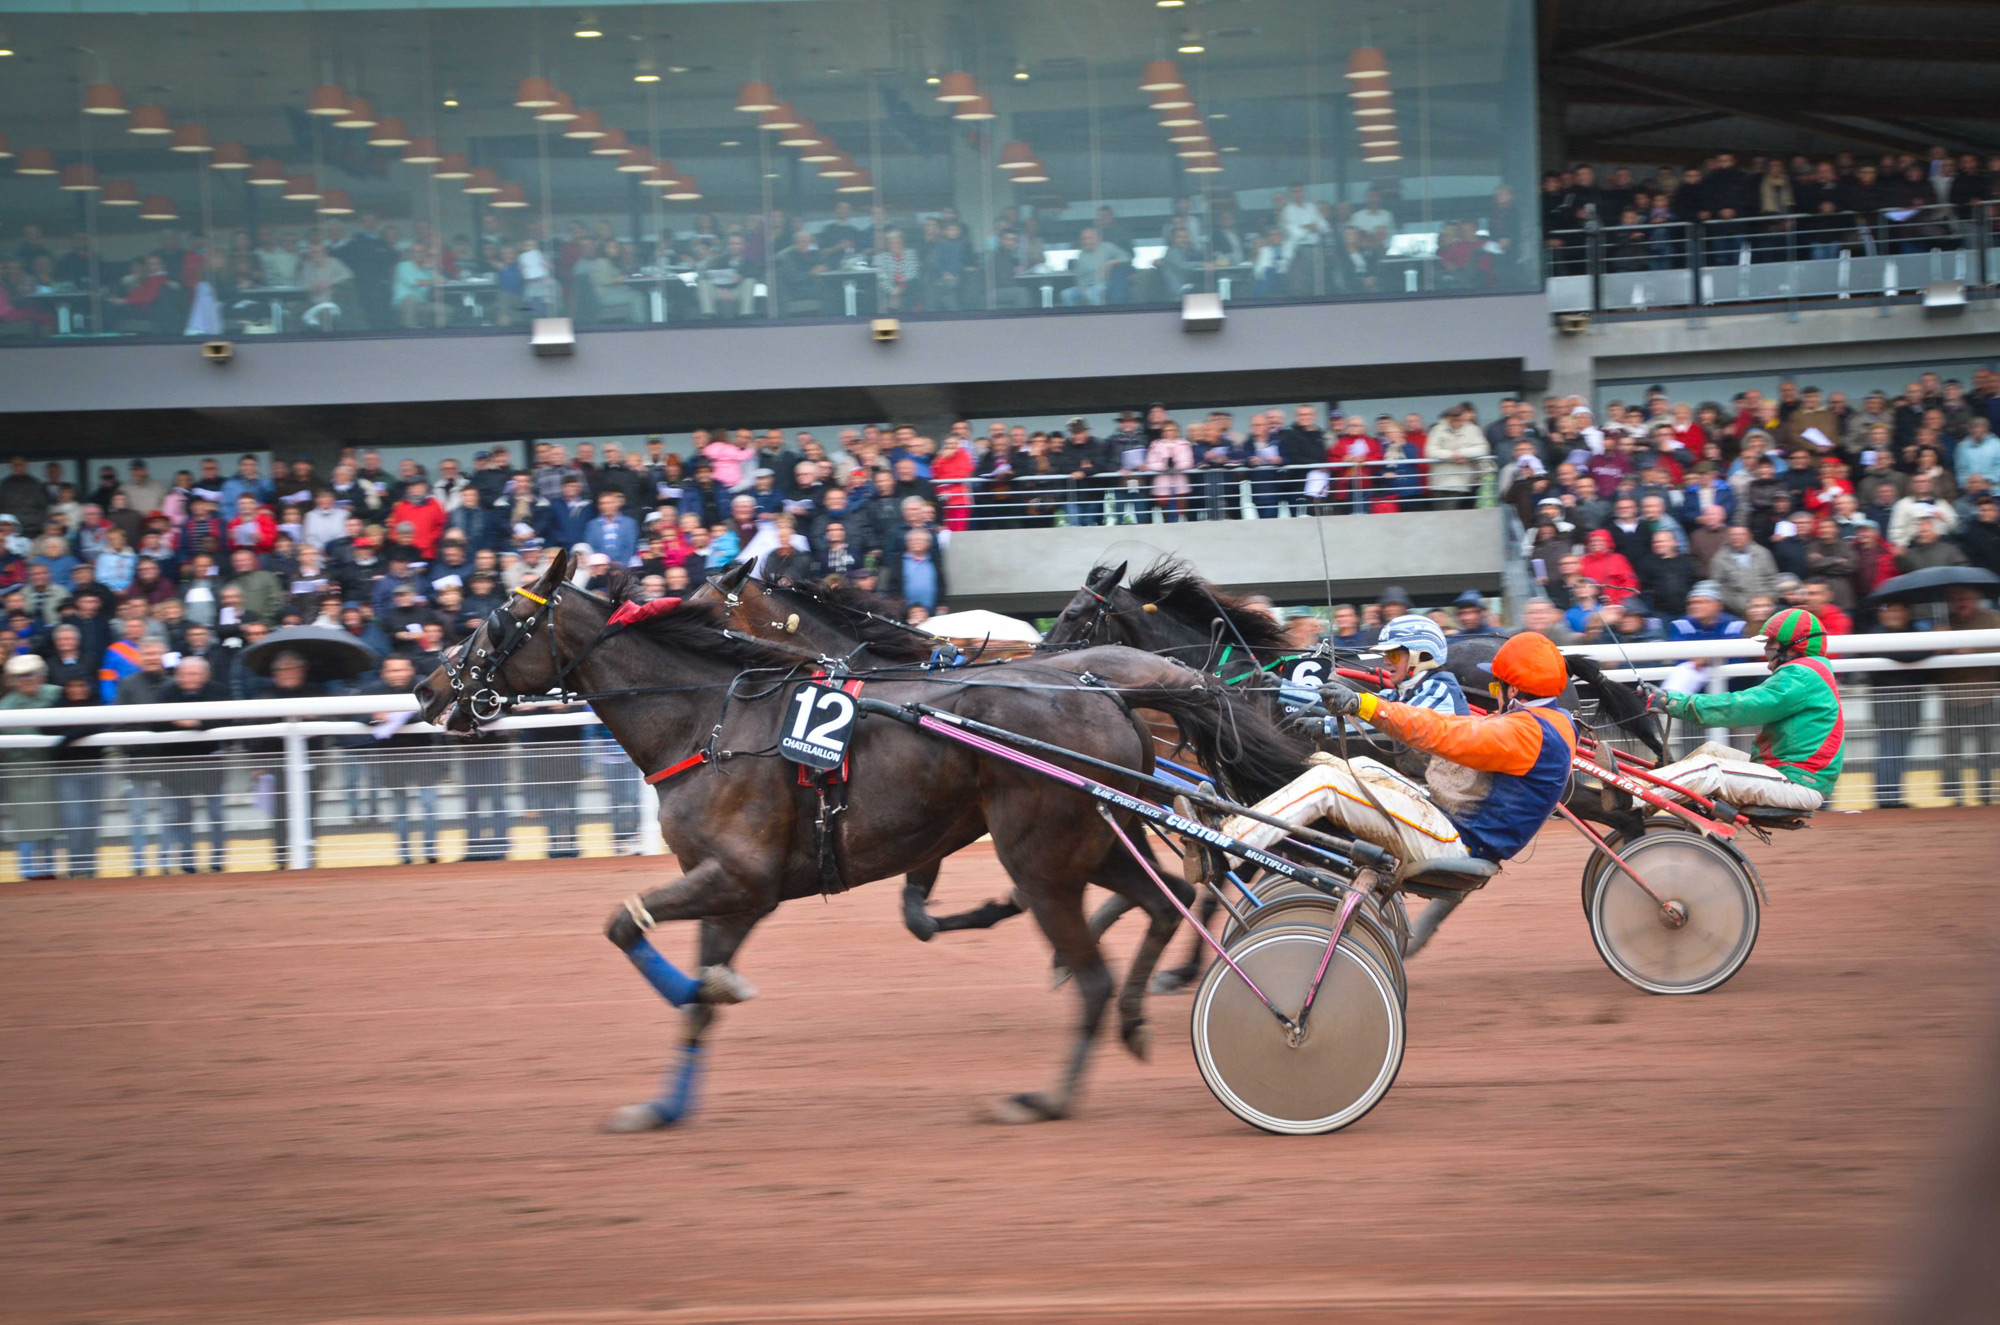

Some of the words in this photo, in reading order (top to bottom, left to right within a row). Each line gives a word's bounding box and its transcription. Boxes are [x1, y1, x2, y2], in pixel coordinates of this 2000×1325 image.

[1292, 660, 1324, 689] 6
[791, 686, 854, 751] 12
[782, 737, 841, 762] CHATELAILLON
[1572, 758, 1616, 781] CUSTOM
[1112, 795, 1138, 809] SPORTS
[1165, 814, 1234, 848] CUSTOM
[1244, 849, 1296, 875] MULTIFLEX
